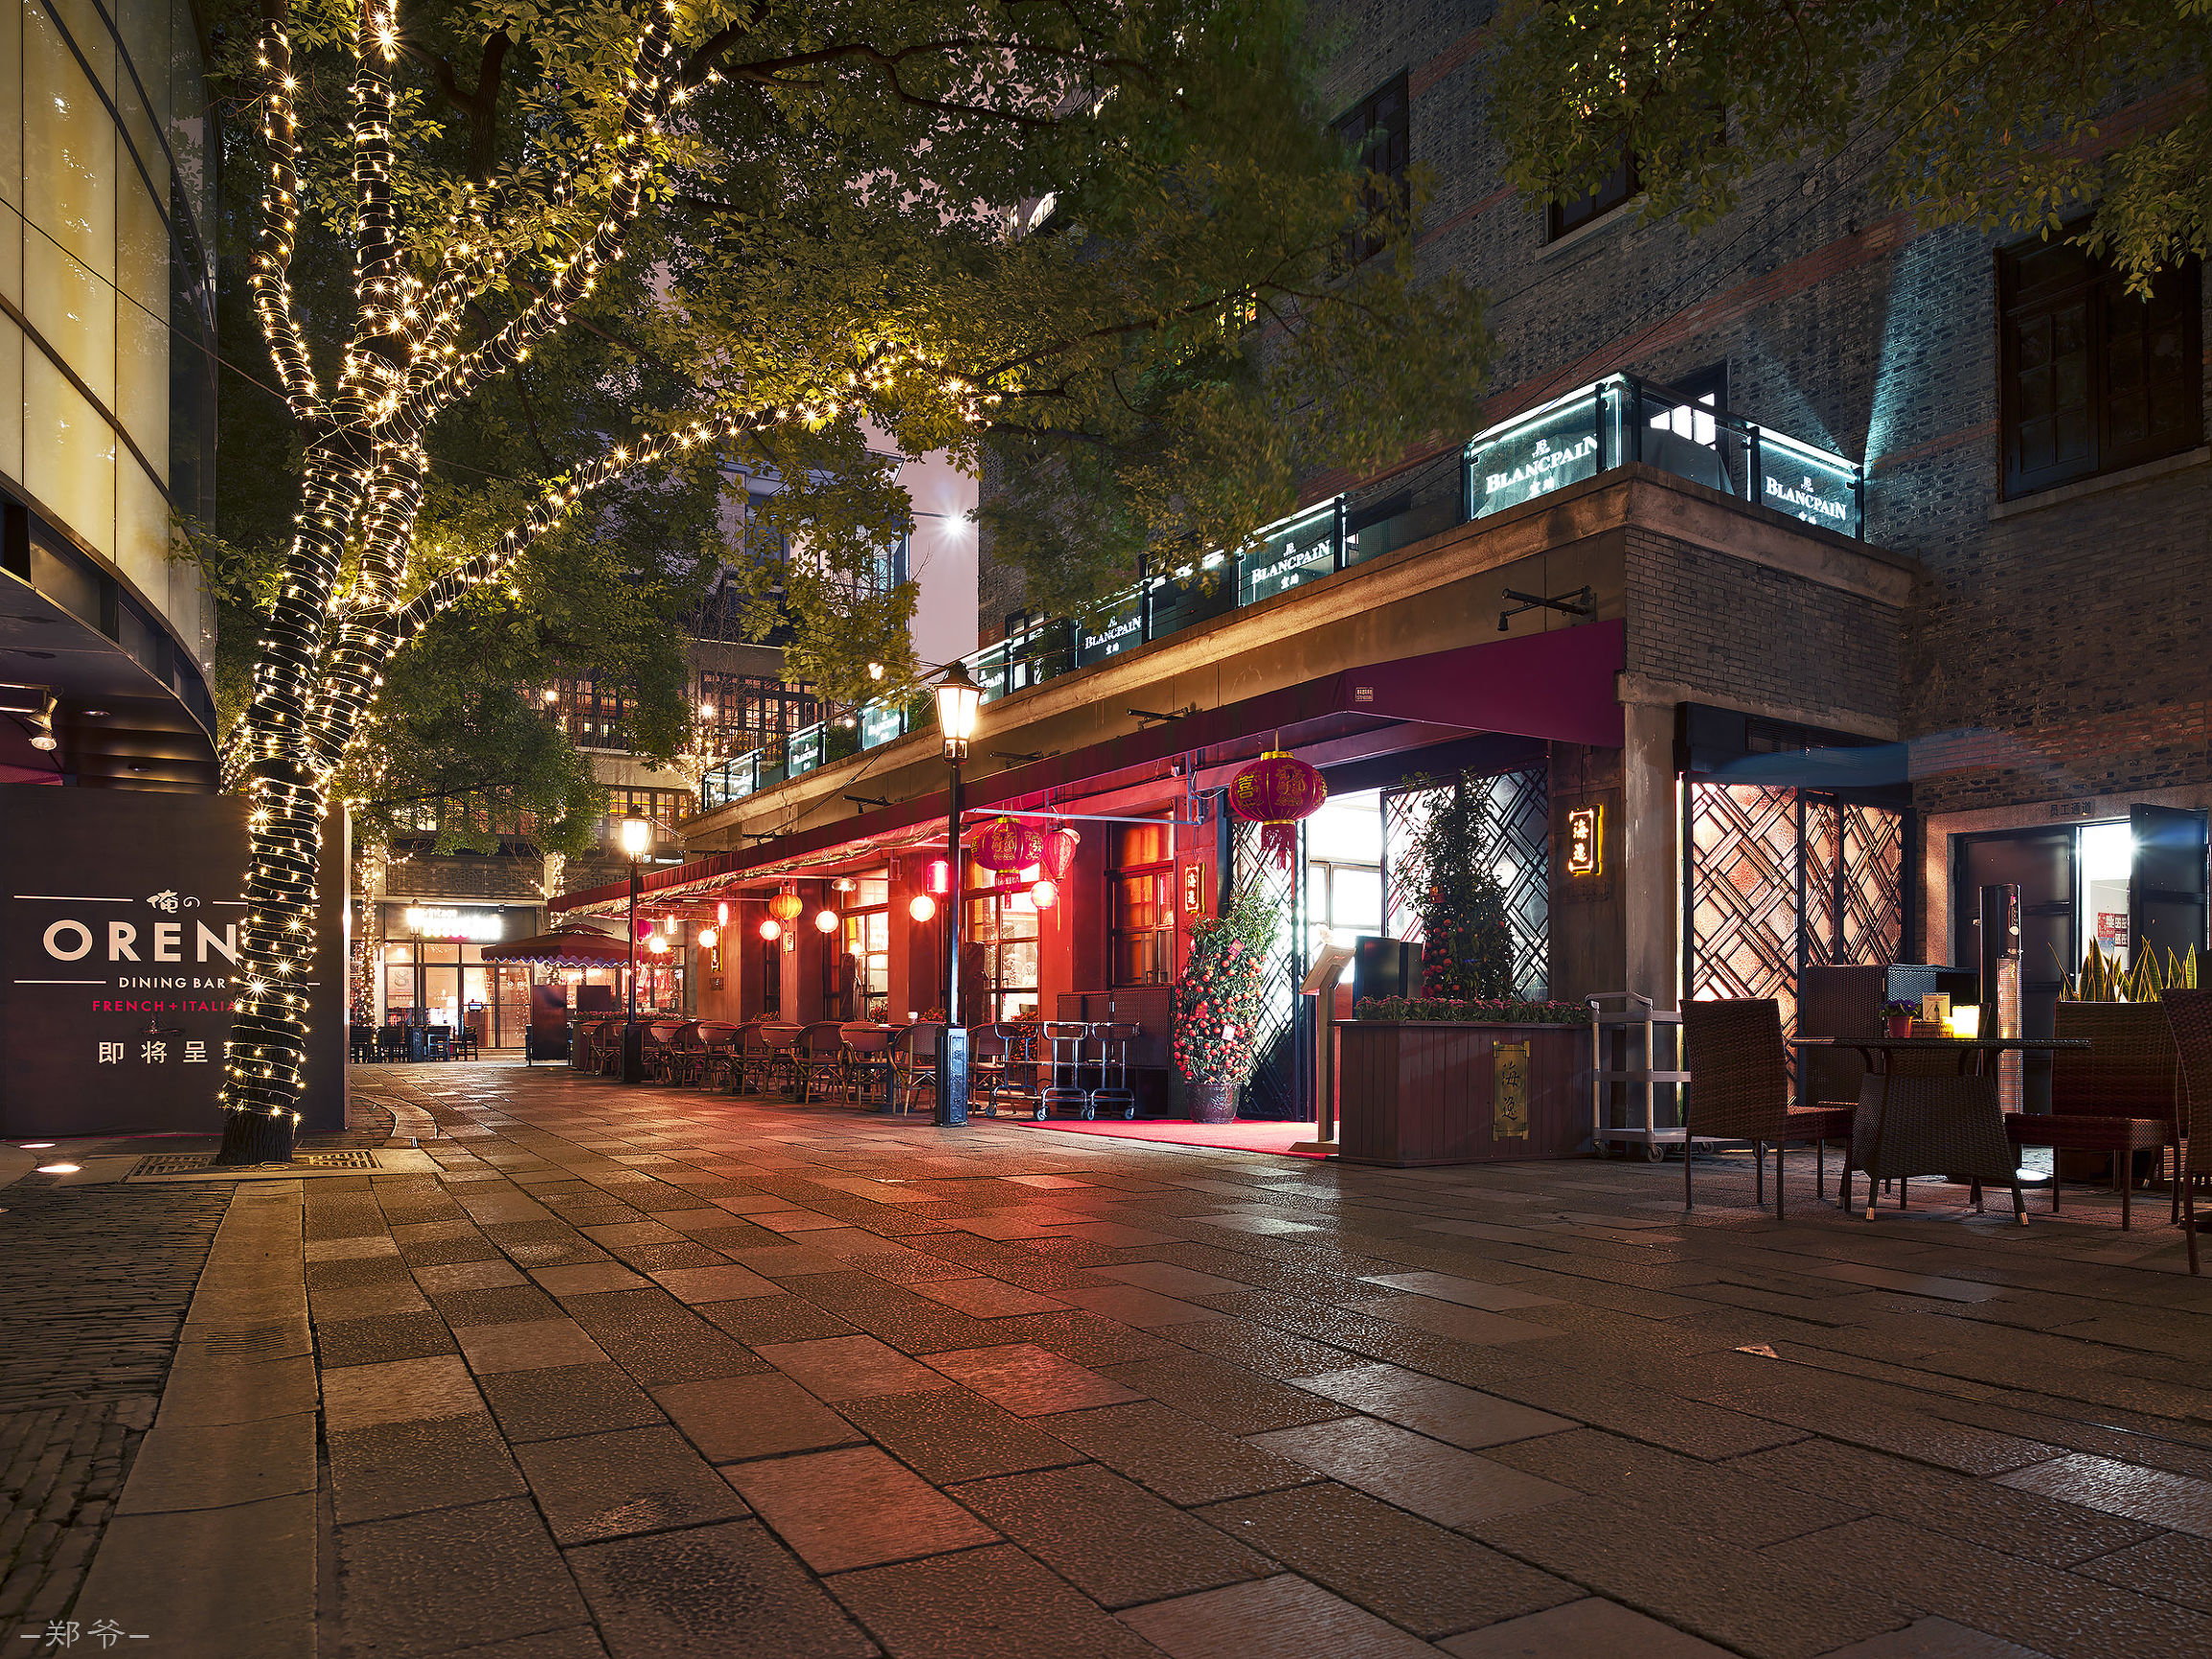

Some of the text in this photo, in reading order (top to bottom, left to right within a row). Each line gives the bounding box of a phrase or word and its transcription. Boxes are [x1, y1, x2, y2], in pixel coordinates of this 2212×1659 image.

[1486, 435, 1598, 494] BLANCPAIN
[1766, 475, 1846, 521] BLANCPAIN
[1251, 539, 1331, 584] BLANCPAIN
[1084, 615, 1142, 649] BLANCPAIN
[2050, 801, 2092, 817] 员工通道
[146, 889, 201, 914] 俺の
[43, 920, 238, 966] OREN
[118, 977, 227, 989] DINING BAR
